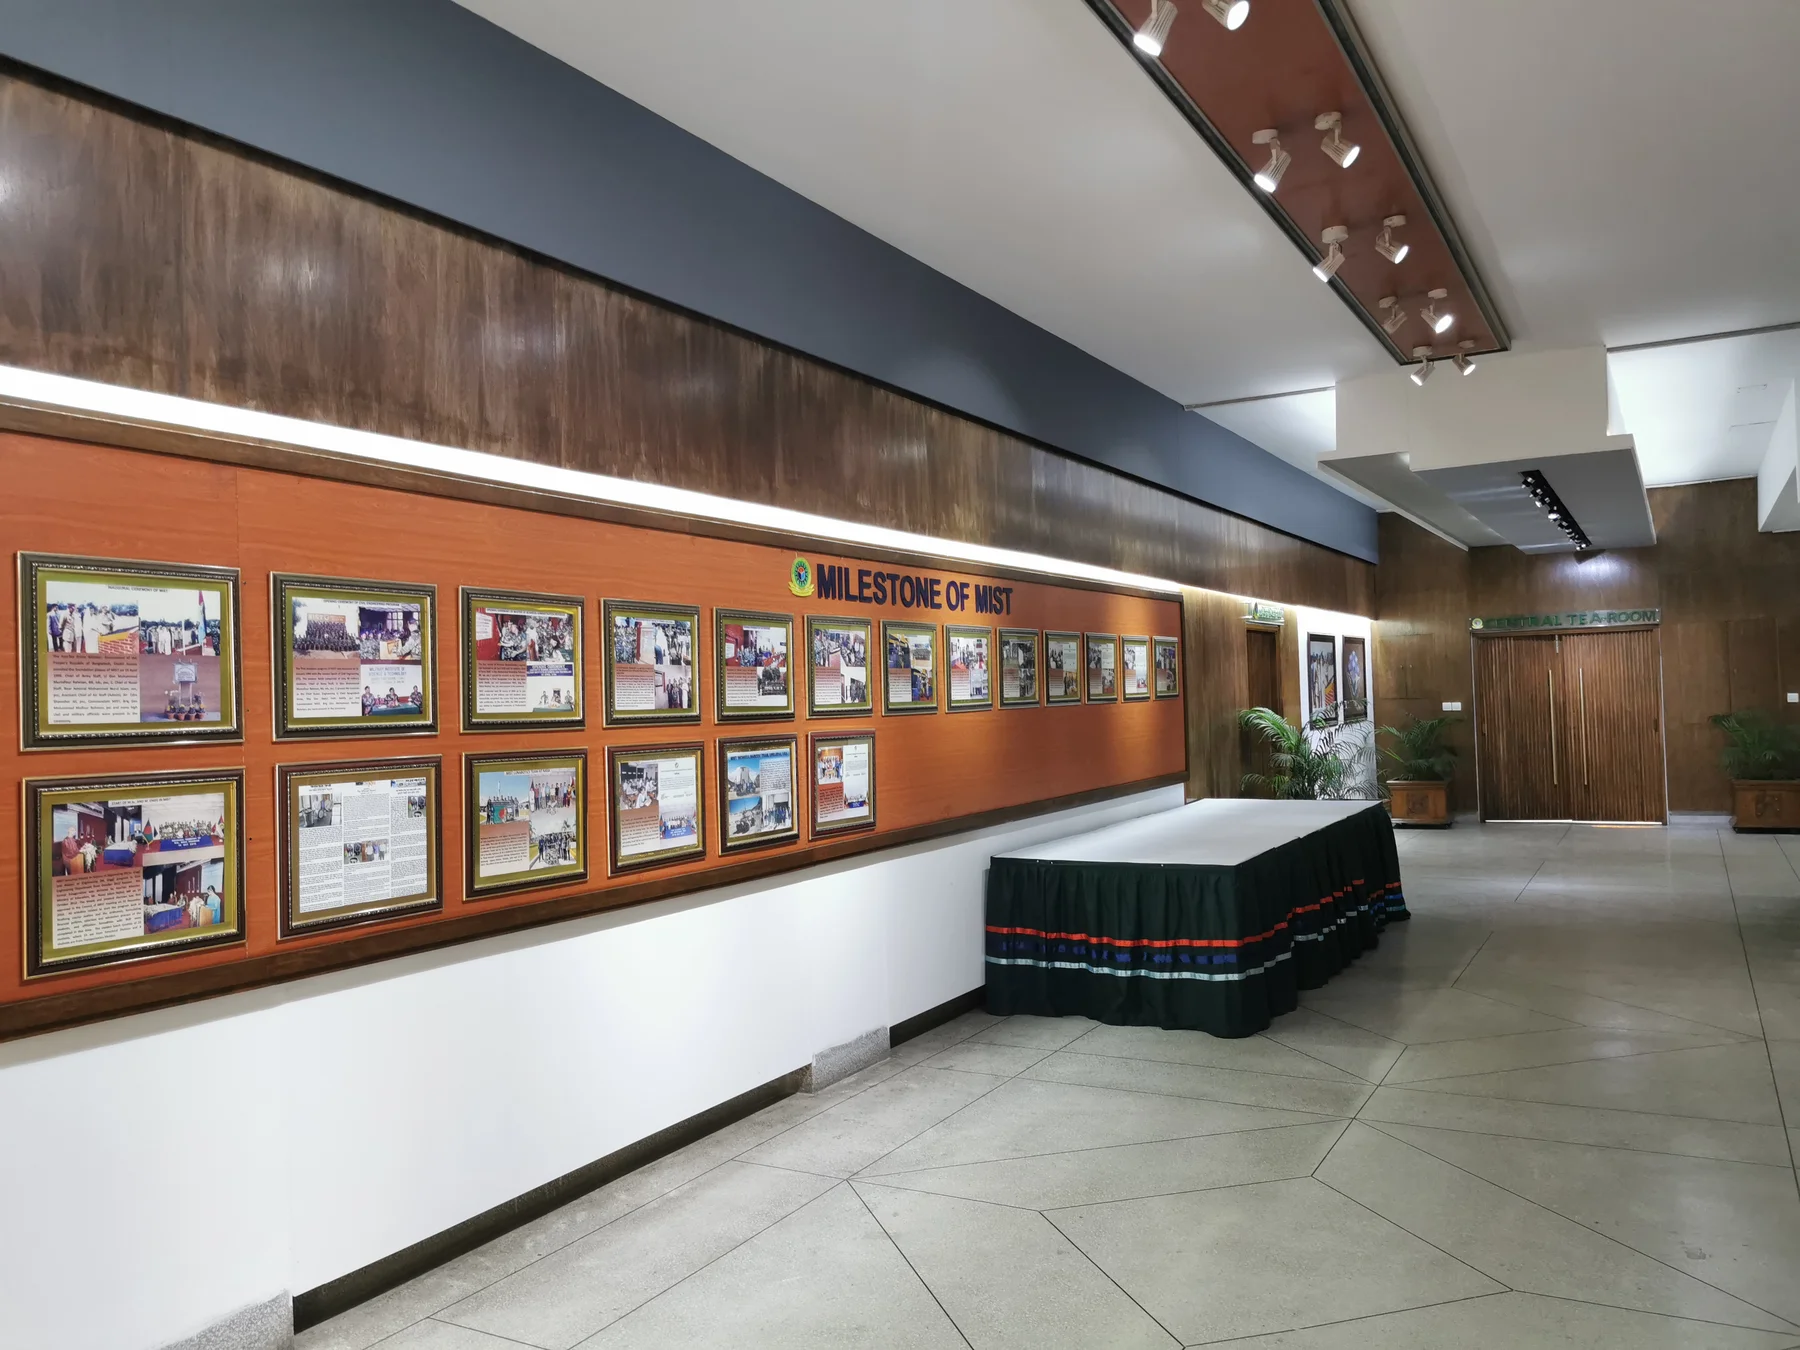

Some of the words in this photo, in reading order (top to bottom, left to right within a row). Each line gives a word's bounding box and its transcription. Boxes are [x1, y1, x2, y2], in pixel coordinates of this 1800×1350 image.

[816, 564, 942, 610] MILESTONE
[946, 580, 970, 612] OF
[975, 584, 1013, 616] MIST
[1484, 614, 1562, 629] CENTRAL
